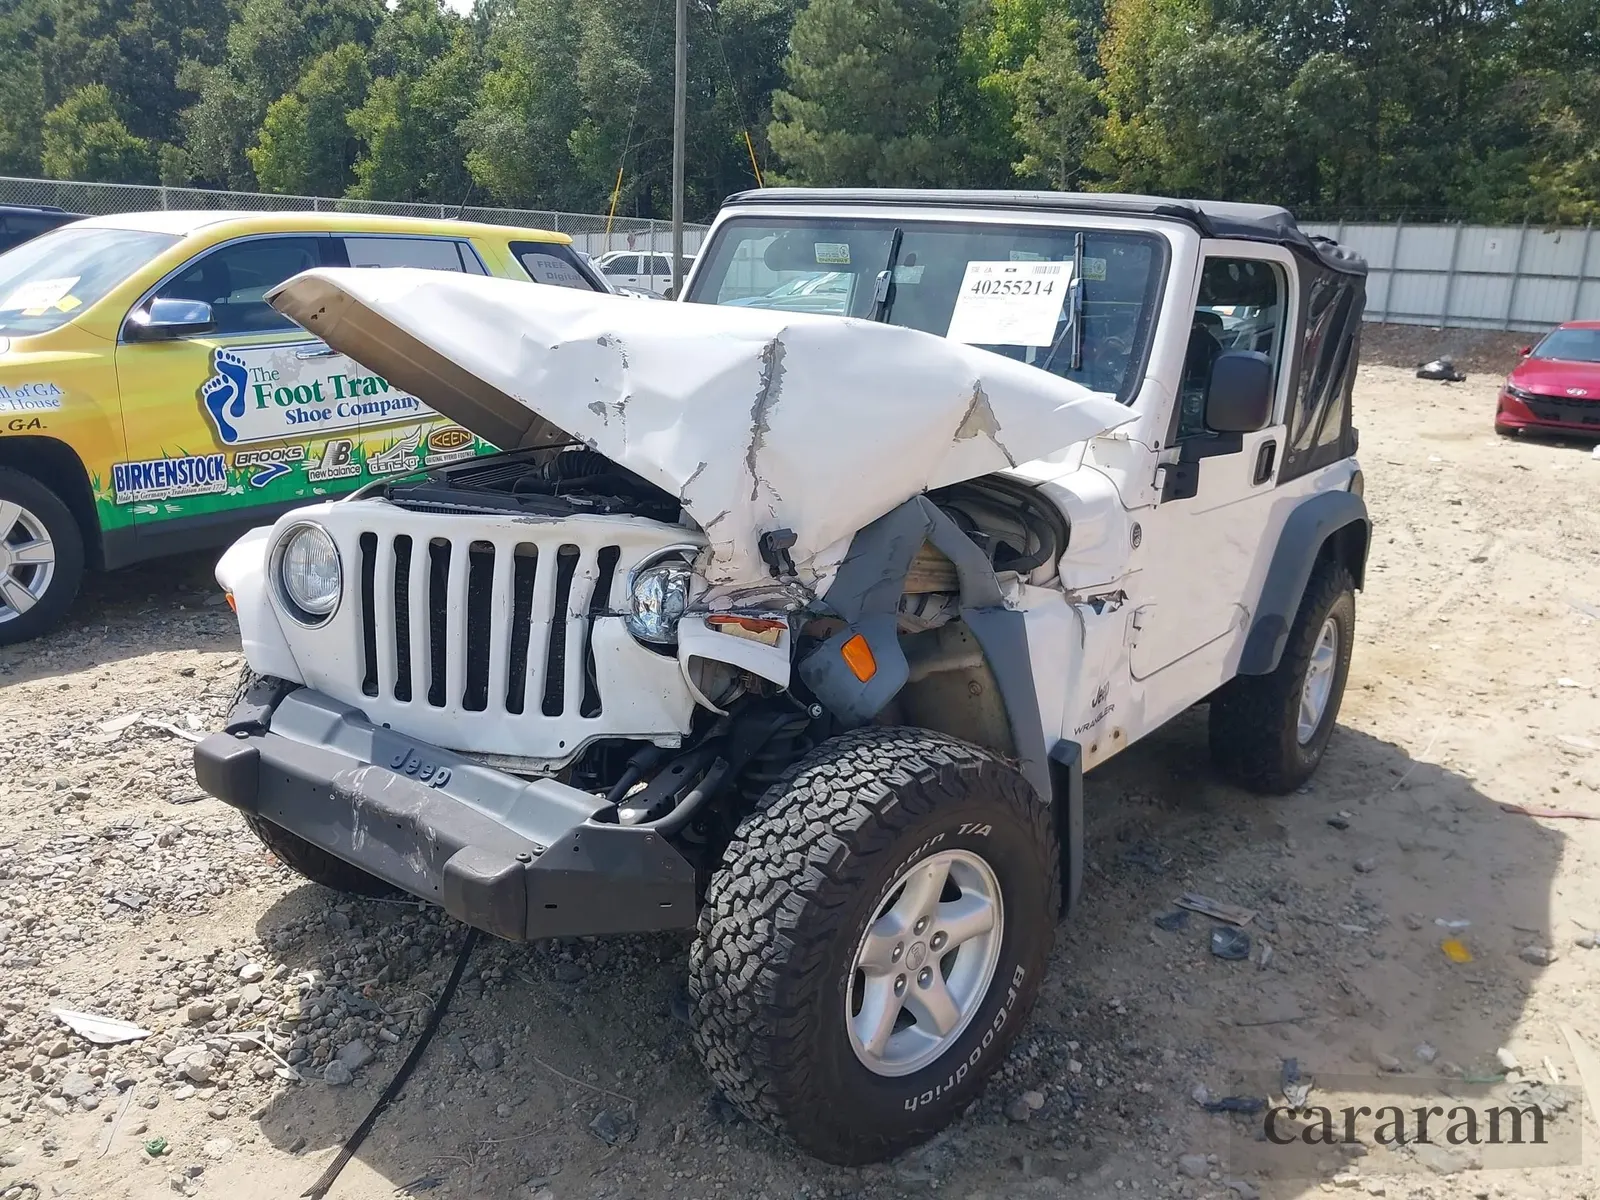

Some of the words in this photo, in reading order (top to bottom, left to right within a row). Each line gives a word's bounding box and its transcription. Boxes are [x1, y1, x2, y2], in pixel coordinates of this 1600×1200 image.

[971, 279, 1054, 296] 40255214
[250, 367, 280, 383] The
[14, 383, 31, 398] of
[33, 382, 66, 396] GA.
[252, 379, 325, 410] Foot
[328, 374, 390, 400] Trav
[8, 398, 61, 410] House
[286, 408, 332, 425] Shoe
[336, 396, 420, 417] Company
[8, 417, 48, 431] GA.
[431, 431, 471, 446] KEEN
[236, 447, 303, 465] BROOKS
[370, 449, 418, 474] dansko
[114, 456, 225, 492] BIRKENSTOCK
[310, 469, 327, 480] new
[327, 465, 361, 477] balance
[1073, 703, 1115, 736] WRANGLER
[389, 747, 452, 789] Jeep
[957, 822, 993, 837] T/A
[904, 964, 1026, 1112] BFGoodrich
